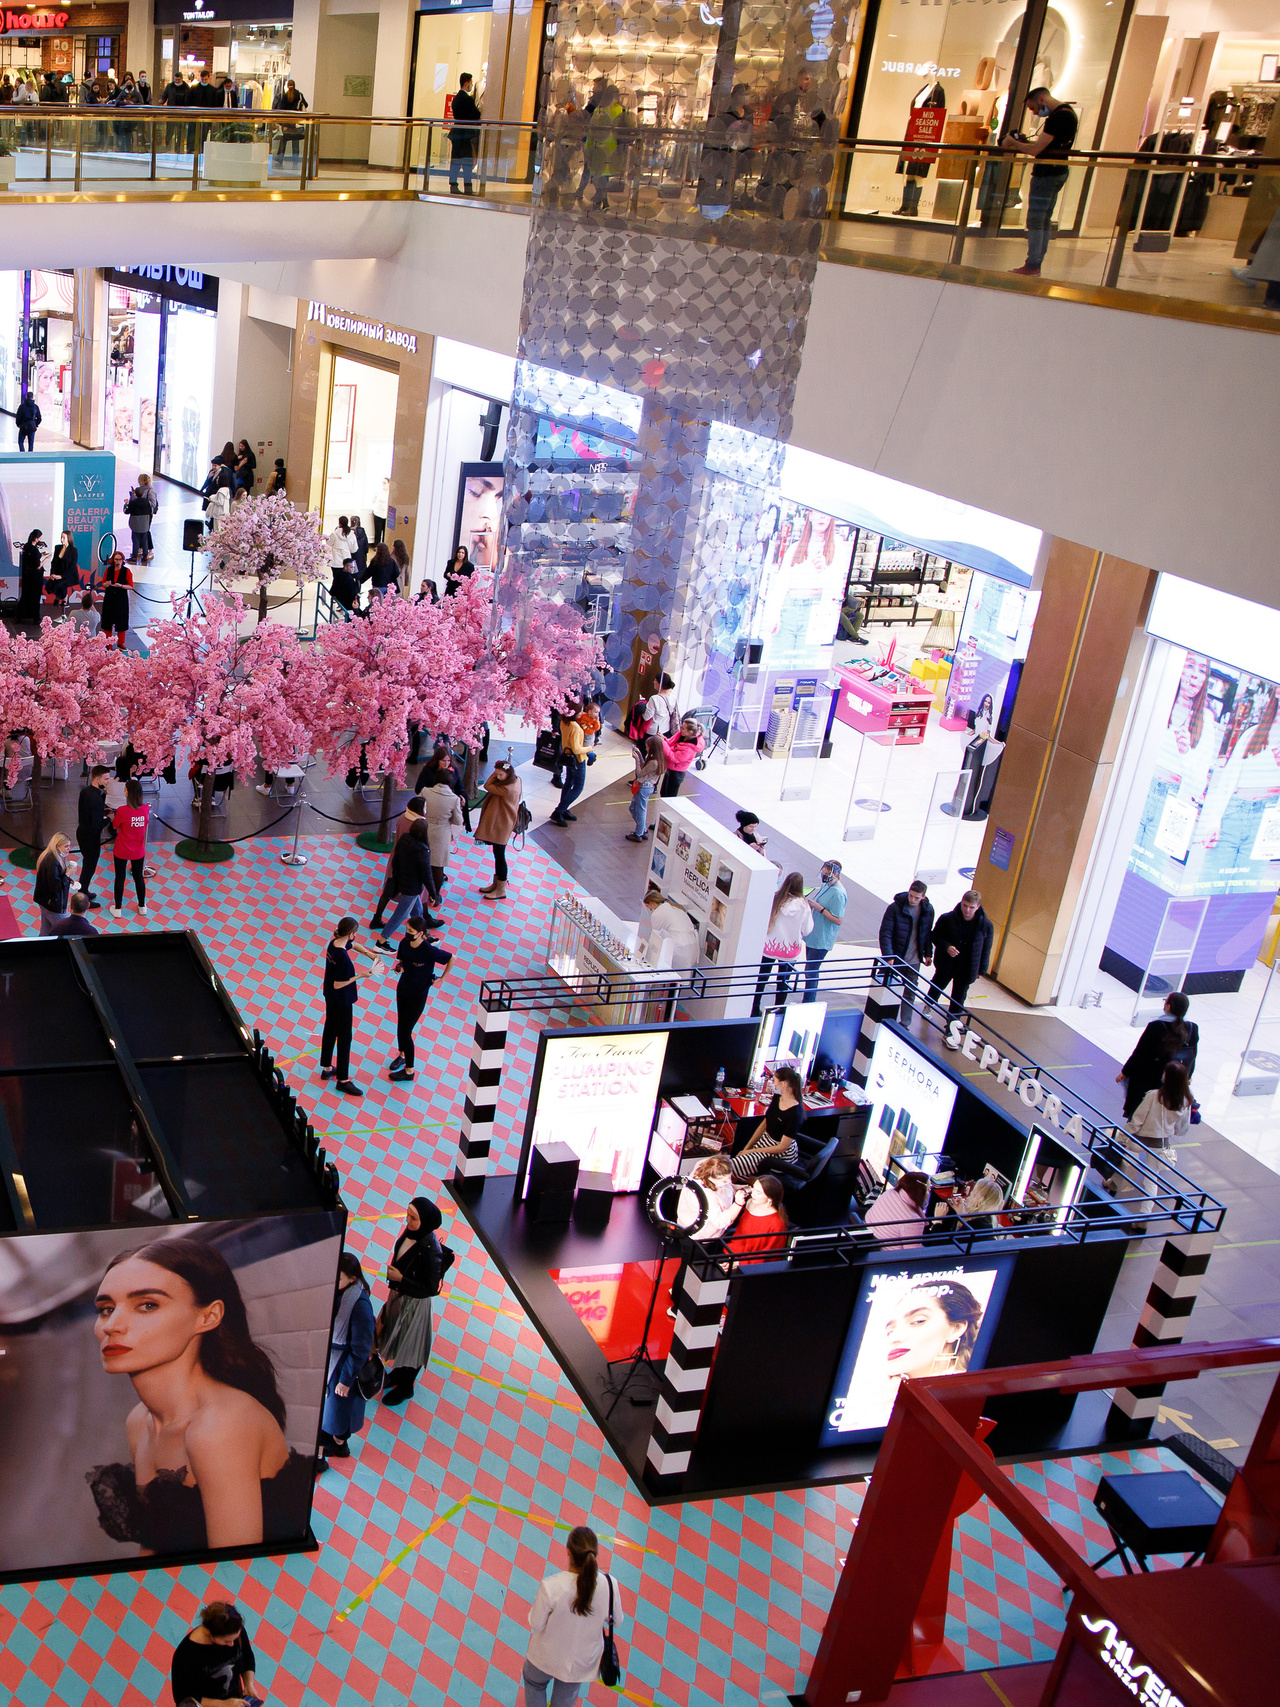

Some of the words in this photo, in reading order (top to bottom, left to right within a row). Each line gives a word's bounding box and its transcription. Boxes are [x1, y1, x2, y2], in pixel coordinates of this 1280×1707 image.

[6, 11, 69, 29] house
[915, 118, 939, 127] SEASON
[918, 126, 933, 134] SALE
[326, 313, 385, 341] ЮВЕЛИРНЫЙ
[384, 328, 417, 354] ЗАВОД
[67, 508, 110, 516] GALERIA
[67, 516, 106, 524] BEAUTY
[67, 524, 96, 533] WEEK
[684, 867, 710, 895] REPLICA
[596, 1041, 653, 1057] Faced
[550, 1061, 655, 1080] PLUMPING
[888, 1046, 940, 1098] SEPHORA
[557, 1080, 641, 1099] STATION
[946, 1019, 1083, 1145] SEPHORA
